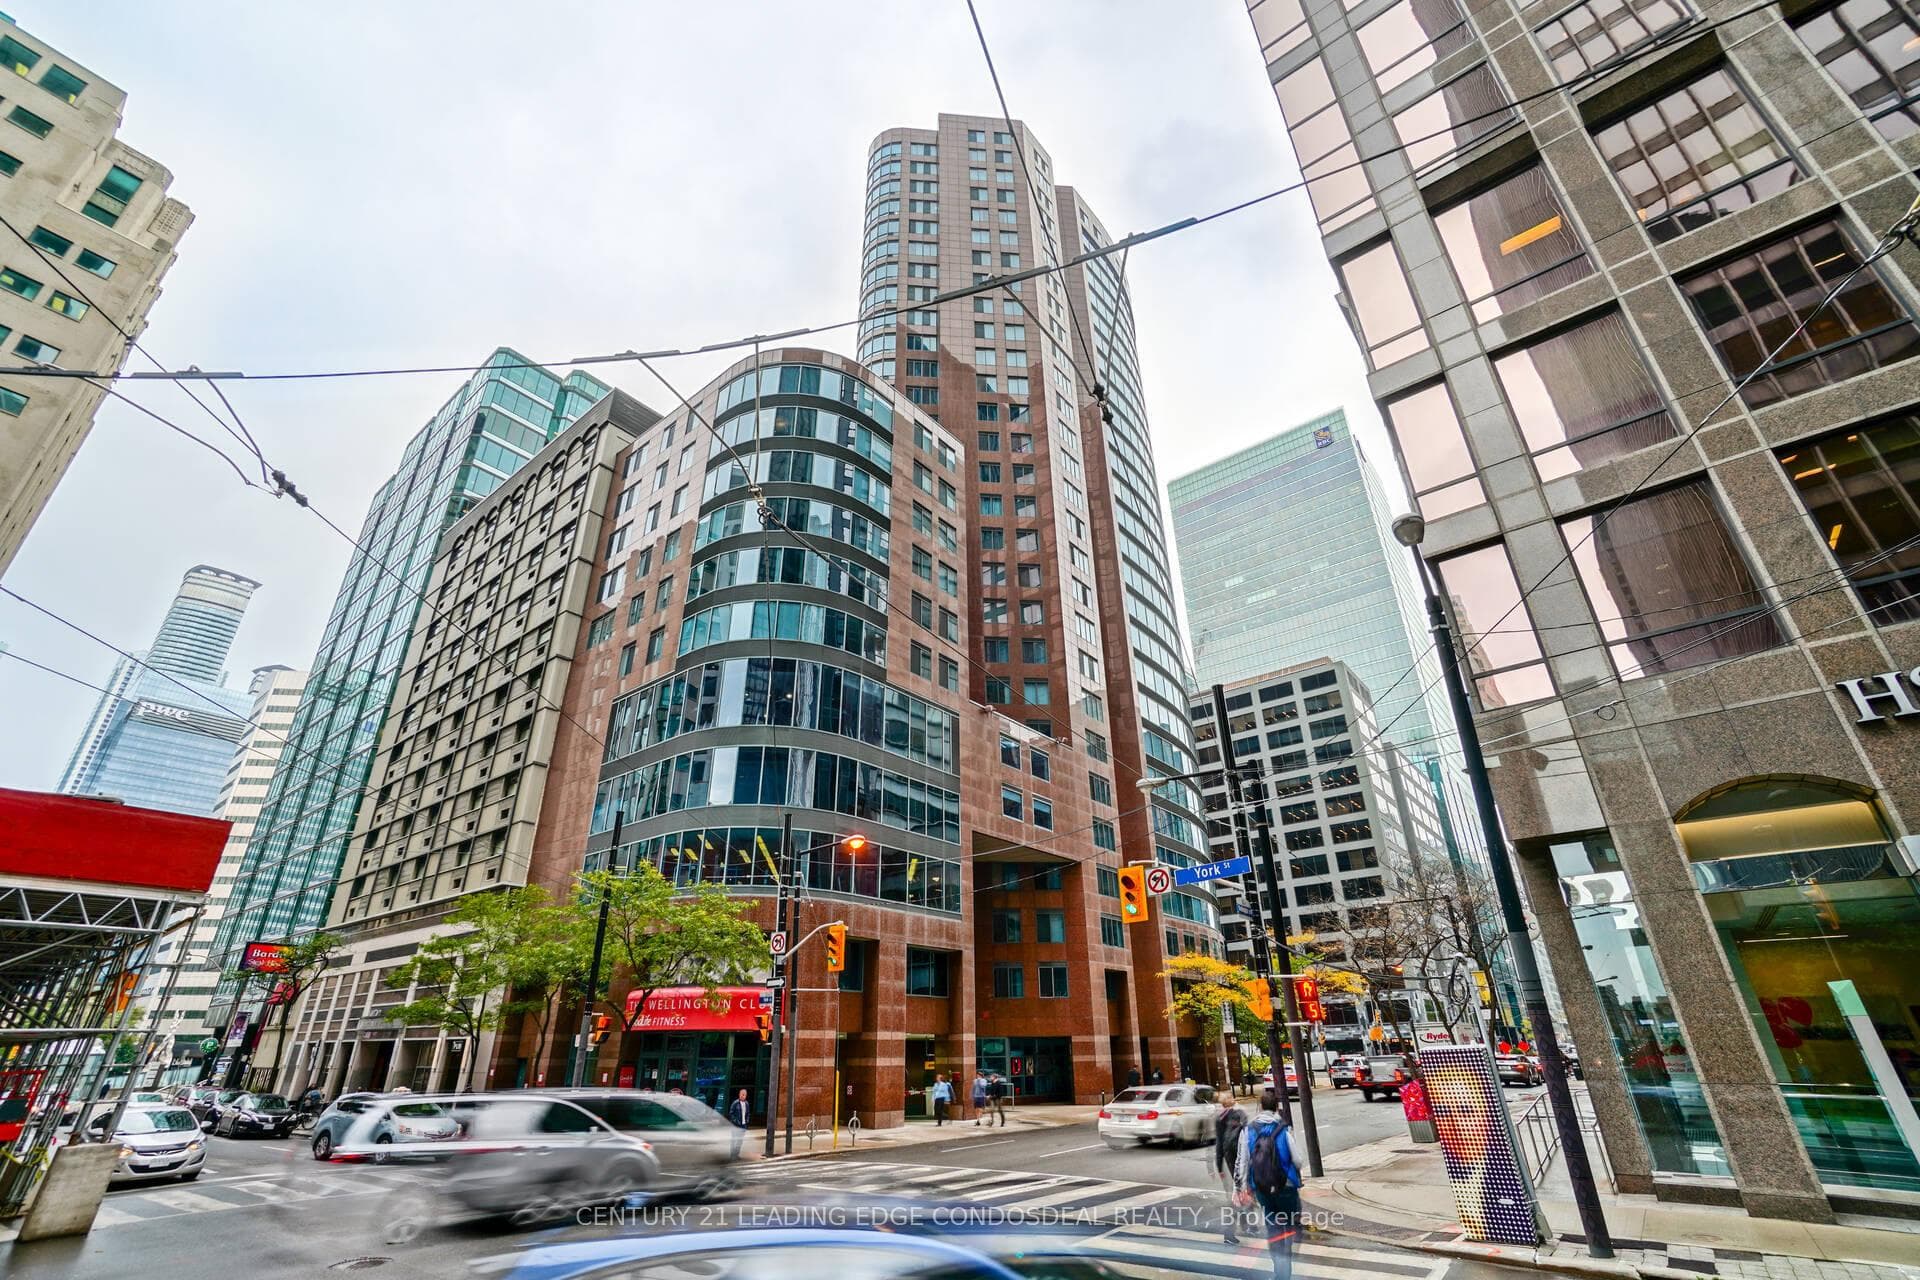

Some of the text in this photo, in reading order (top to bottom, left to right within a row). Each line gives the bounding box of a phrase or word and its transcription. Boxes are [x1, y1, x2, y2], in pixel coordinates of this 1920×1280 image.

[136, 701, 191, 720] pwc
[1194, 864, 1221, 878] York
[649, 999, 731, 1010] WELLINGTON
[652, 1016, 686, 1026] FITNESS
